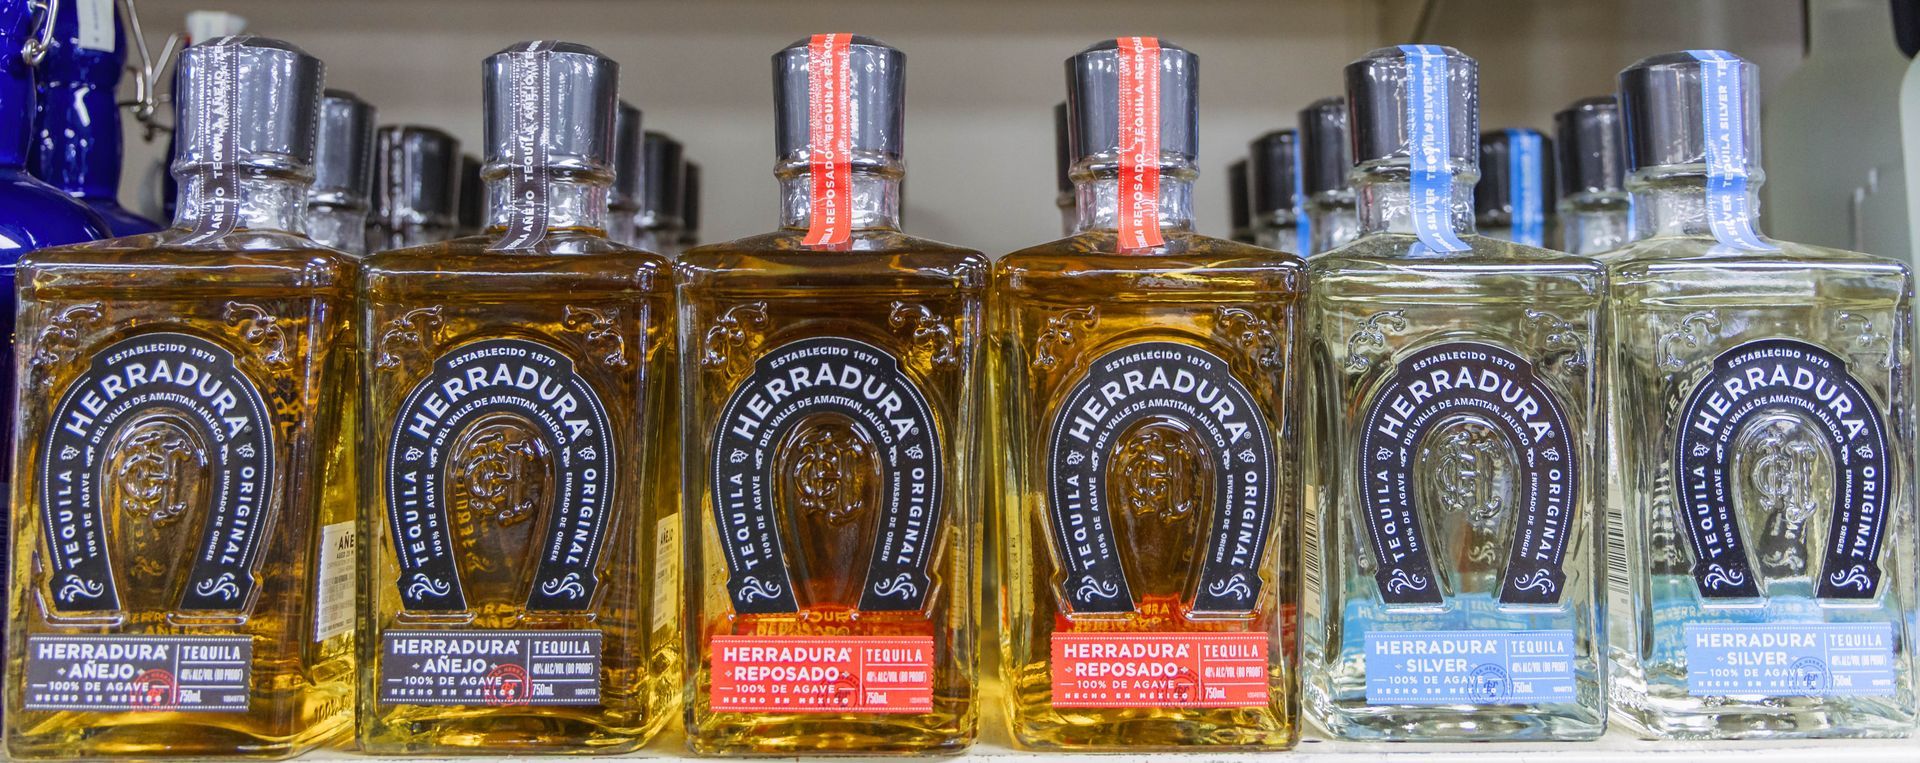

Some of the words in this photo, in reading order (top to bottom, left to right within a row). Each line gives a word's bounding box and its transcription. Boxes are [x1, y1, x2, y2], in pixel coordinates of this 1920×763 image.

[1135, 84, 1144, 143] TEQUILA
[1718, 85, 1729, 129] SILVER
[825, 149, 835, 224] REPOSADO
[1133, 153, 1143, 227] REPOSADO
[523, 190, 535, 233] AÑEJO
[107, 343, 186, 365] ESTABLECIDO
[191, 348, 216, 363] 1870
[449, 348, 526, 369] ESTABLECIDO
[531, 352, 556, 367] 1870
[770, 347, 849, 368] ESTABLECIDO
[853, 351, 878, 365] 1870
[1105, 351, 1182, 372] ESTABLECIDO
[1187, 355, 1212, 370] 1870
[1413, 352, 1486, 371] ESTABLECIDO
[1491, 356, 1516, 371] 1870
[1728, 349, 1800, 369] ESTABLECIDO
[1805, 354, 1830, 368] 1870
[65, 359, 250, 439] HERRADURA
[409, 363, 591, 441] HERRADURA
[732, 363, 915, 441] HERRADURA
[1069, 366, 1248, 444] HERRADURA
[1378, 366, 1551, 443] HERRADURA
[1695, 365, 1866, 440] HERRADURA
[94, 428, 107, 444] DEL
[104, 401, 132, 425] VALLE
[132, 395, 147, 406] DE
[150, 393, 198, 410] AMATITAN,
[197, 407, 224, 442] JALISCO
[436, 430, 450, 446] DEL
[447, 403, 473, 426] VALLE
[474, 398, 488, 407] DE
[490, 395, 538, 414] AMATITAN,
[538, 410, 565, 444] JALISCO
[760, 432, 773, 447] DEL
[771, 404, 797, 427] VALLE
[797, 398, 812, 408] DE
[814, 395, 863, 413] AMATITAN,
[863, 409, 891, 444] JALISCO
[1097, 434, 1109, 450] DEL
[1107, 407, 1132, 429] VALLE
[1133, 401, 1146, 411] DE
[1148, 399, 1196, 417] AMATITAN,
[1196, 413, 1225, 447] JALISCO
[1404, 431, 1417, 446] DEL
[1415, 404, 1438, 428] VALLE
[1438, 399, 1452, 409] DE
[1454, 398, 1500, 416] AMATITAN,
[1501, 411, 1529, 445] JALISCO
[1720, 428, 1733, 443] DEL
[1730, 401, 1753, 425] VALLE
[1754, 397, 1767, 407] DE
[1769, 395, 1815, 413] AMATITAN,
[1815, 409, 1843, 443] JALISCO
[80, 473, 90, 508] AGAVE
[220, 470, 230, 512] ENVASADO
[424, 474, 434, 508] AGAVE
[564, 472, 572, 514] ENVASADO
[753, 475, 762, 510] AGAVE
[891, 471, 900, 513] ENVASADO
[1089, 477, 1098, 511] AGAVE
[1225, 474, 1233, 516] ENVASADO
[1398, 473, 1407, 507] AGAVE
[1529, 472, 1537, 512] ENVASADO
[1714, 469, 1723, 502] AGAVE
[1843, 470, 1852, 509] ENVASADO
[58, 470, 83, 568] TEQUILA
[83, 513, 92, 528] DE
[216, 515, 223, 527] DE
[222, 466, 255, 564] ORIGINAL
[404, 471, 429, 567] TEQUILA
[429, 513, 437, 528] DE
[559, 516, 566, 528] DE
[566, 468, 597, 564] ORIGINAL
[731, 472, 758, 570] TEQUILA
[756, 515, 765, 529] DE
[890, 516, 897, 528] DE
[897, 467, 924, 564] ORIGINAL
[1067, 474, 1095, 570] TEQUILA
[1094, 516, 1101, 530] DE
[1222, 518, 1229, 530] DE
[1231, 471, 1257, 567] ORIGINAL
[1377, 470, 1404, 563] TEQUILA
[1402, 510, 1410, 523] DE
[1527, 515, 1533, 526] DE
[1535, 469, 1560, 561] ORIGINAL
[1694, 466, 1721, 557] TEQUILA
[1718, 506, 1726, 520] DE
[1843, 512, 1849, 523] DE
[1851, 466, 1875, 558] ORIGINAL
[87, 532, 97, 557] 100%
[207, 530, 220, 561] ORIGEN
[433, 532, 443, 556] 100%
[551, 531, 563, 561] ORIGEN
[761, 533, 772, 558] 100%
[882, 530, 894, 561] ORIGEN
[1098, 533, 1109, 559] 100%
[1216, 533, 1227, 563] ORIGEN
[1407, 527, 1417, 552] 100%
[1520, 529, 1532, 557] ORIGEN
[1723, 524, 1734, 548] 100%
[1837, 526, 1847, 554] ORIGEN
[38, 643, 167, 659] HERRADURA
[183, 646, 241, 660] TEQUILA
[394, 639, 519, 654] HERRADURA
[534, 641, 590, 654] TEQUILA
[1064, 643, 1189, 658] HERRADURA
[1204, 645, 1258, 657] TEQUILA
[1376, 640, 1497, 654] HERRADURA
[1512, 640, 1564, 653] TEQUILA
[1696, 633, 1815, 648] HERRADURA
[1830, 634, 1882, 646] TEQUILA
[423, 656, 487, 673] AÑEJO
[724, 647, 851, 662] HERRADURA
[866, 649, 922, 662] TEQUILA
[1407, 658, 1467, 672] SILVER
[1727, 651, 1788, 665] SILVER
[68, 660, 134, 679] AÑEJO
[404, 677, 433, 685] 100%
[440, 677, 455, 685] DE
[460, 677, 502, 685] AGAVE
[735, 666, 839, 681] REPOSADO
[1076, 662, 1178, 677] REPOSADO
[1389, 676, 1417, 684] 100%
[1424, 676, 1438, 684] DE
[1444, 676, 1484, 684] AGAVE
[1710, 668, 1738, 677] 100%
[1744, 668, 1759, 677] DE
[1765, 668, 1804, 677] AGAVE
[50, 682, 79, 691] 100%
[84, 682, 100, 691] DE
[106, 682, 149, 691] AGAVE
[736, 684, 765, 693] 100%
[772, 684, 787, 693] DE
[793, 684, 835, 694] AGAVE
[1077, 680, 1107, 688] 100%
[1112, 680, 1127, 688] DE
[1134, 680, 1175, 689] AGAVE
